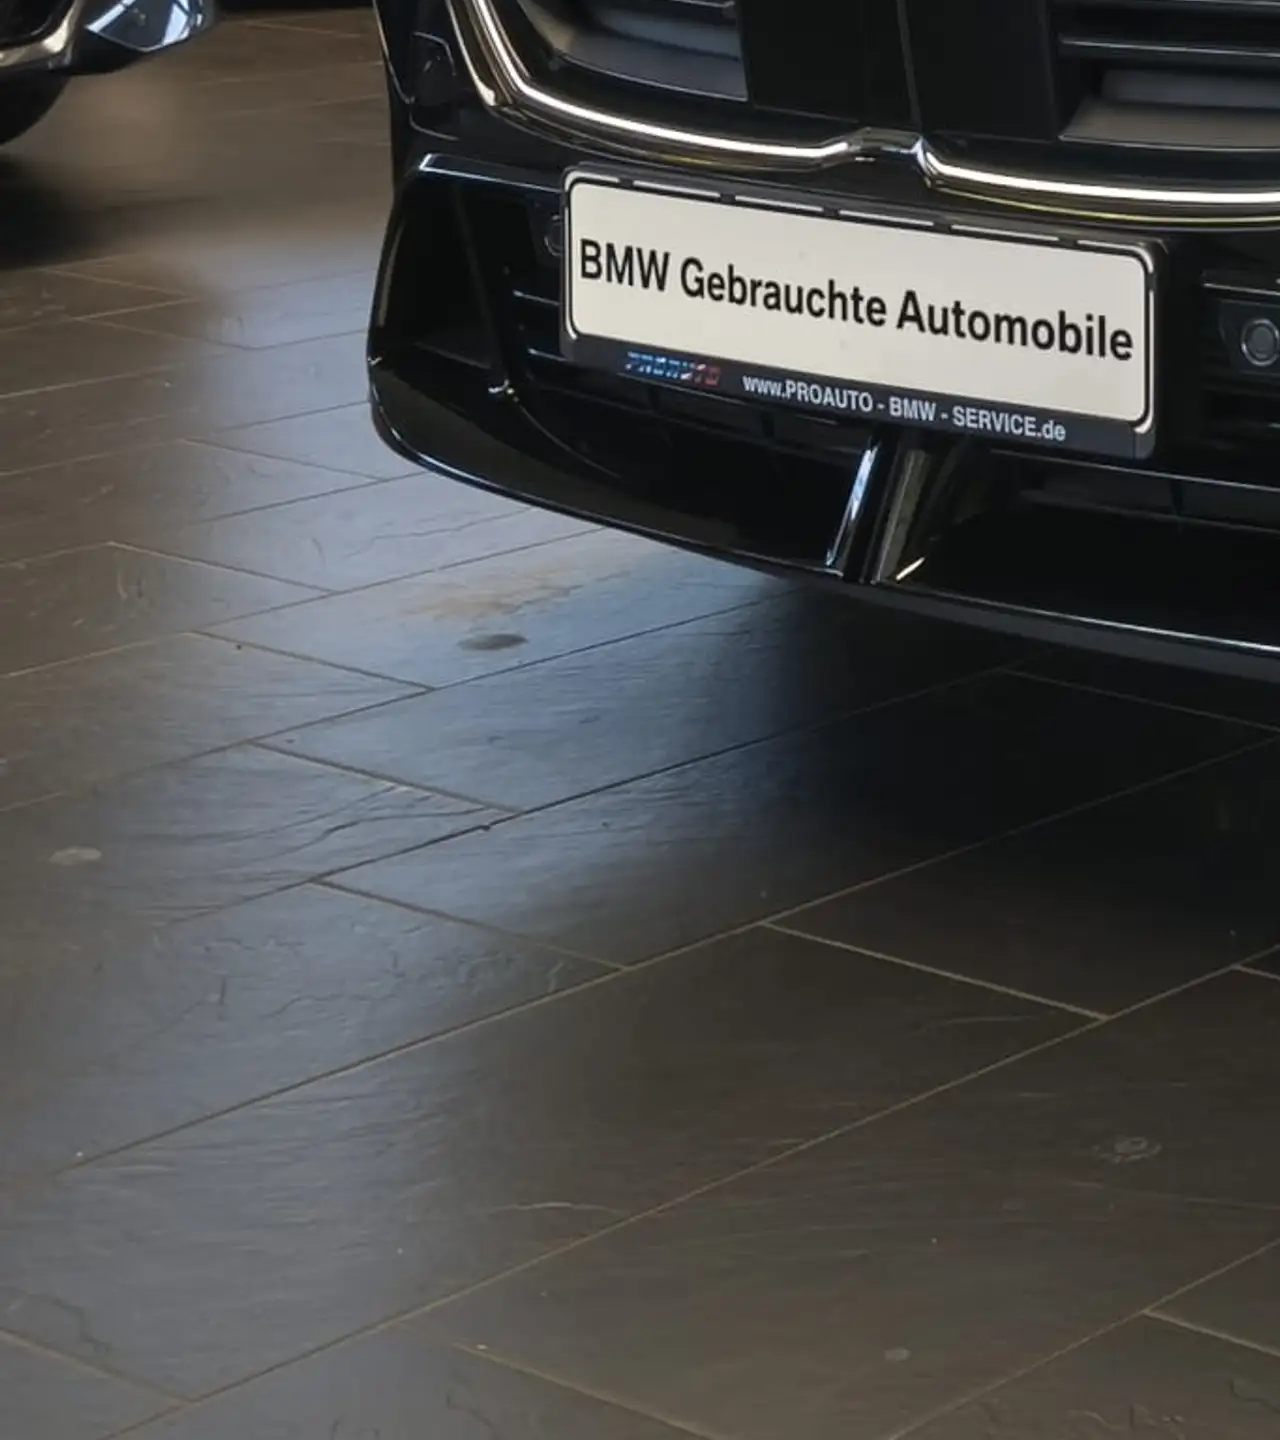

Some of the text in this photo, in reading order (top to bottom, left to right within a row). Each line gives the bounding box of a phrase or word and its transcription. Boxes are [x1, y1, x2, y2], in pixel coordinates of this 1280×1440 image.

[579, 238, 1134, 361] BMW Gebrauchte Automobile
[742, 375, 873, 412] www.PROAUTO
[889, 396, 937, 422] BMW
[952, 405, 1067, 442] SERVICE.de
